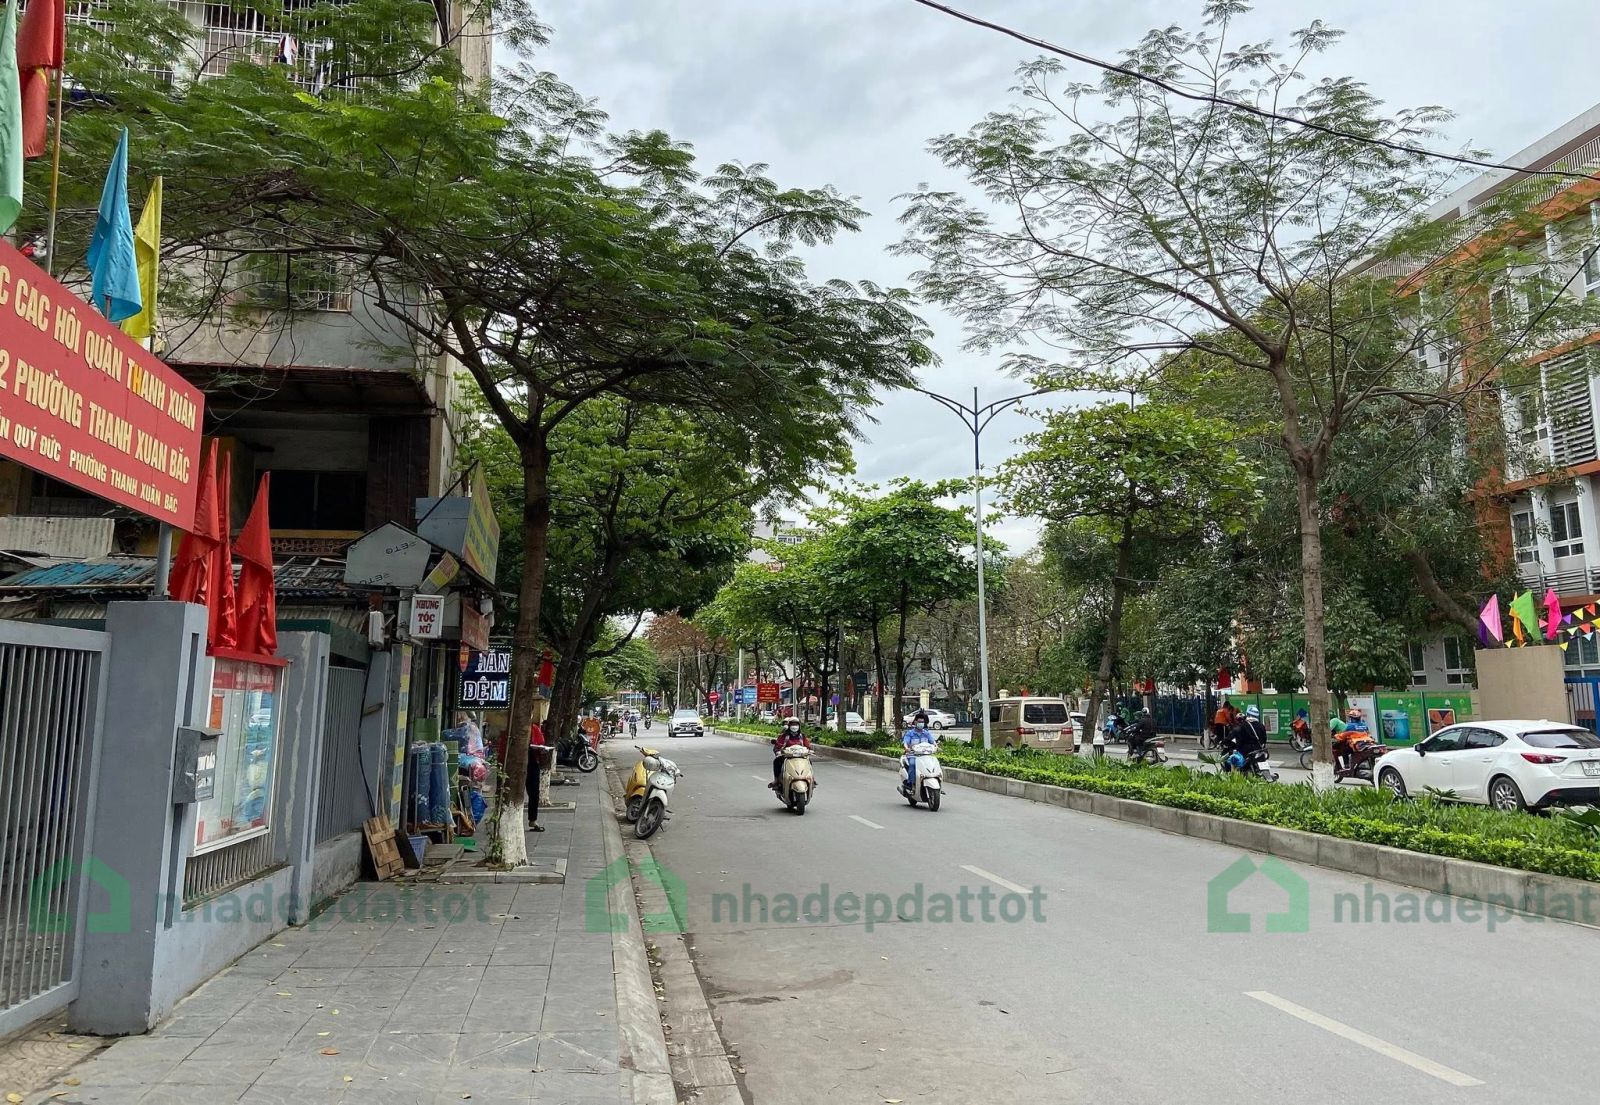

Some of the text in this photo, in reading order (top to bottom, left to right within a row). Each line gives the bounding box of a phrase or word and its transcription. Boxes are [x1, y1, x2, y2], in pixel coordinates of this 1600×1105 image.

[0, 349, 10, 390] 2
[14, 358, 83, 429] PHƯỜNG
[88, 401, 133, 455] THANH
[127, 357, 166, 411] THANH
[167, 392, 197, 432] XUÂN
[14, 424, 37, 451] QUÝ
[69, 448, 108, 483] PHƯỜNG
[110, 468, 138, 497] THANH
[417, 611, 435, 622] TÓC
